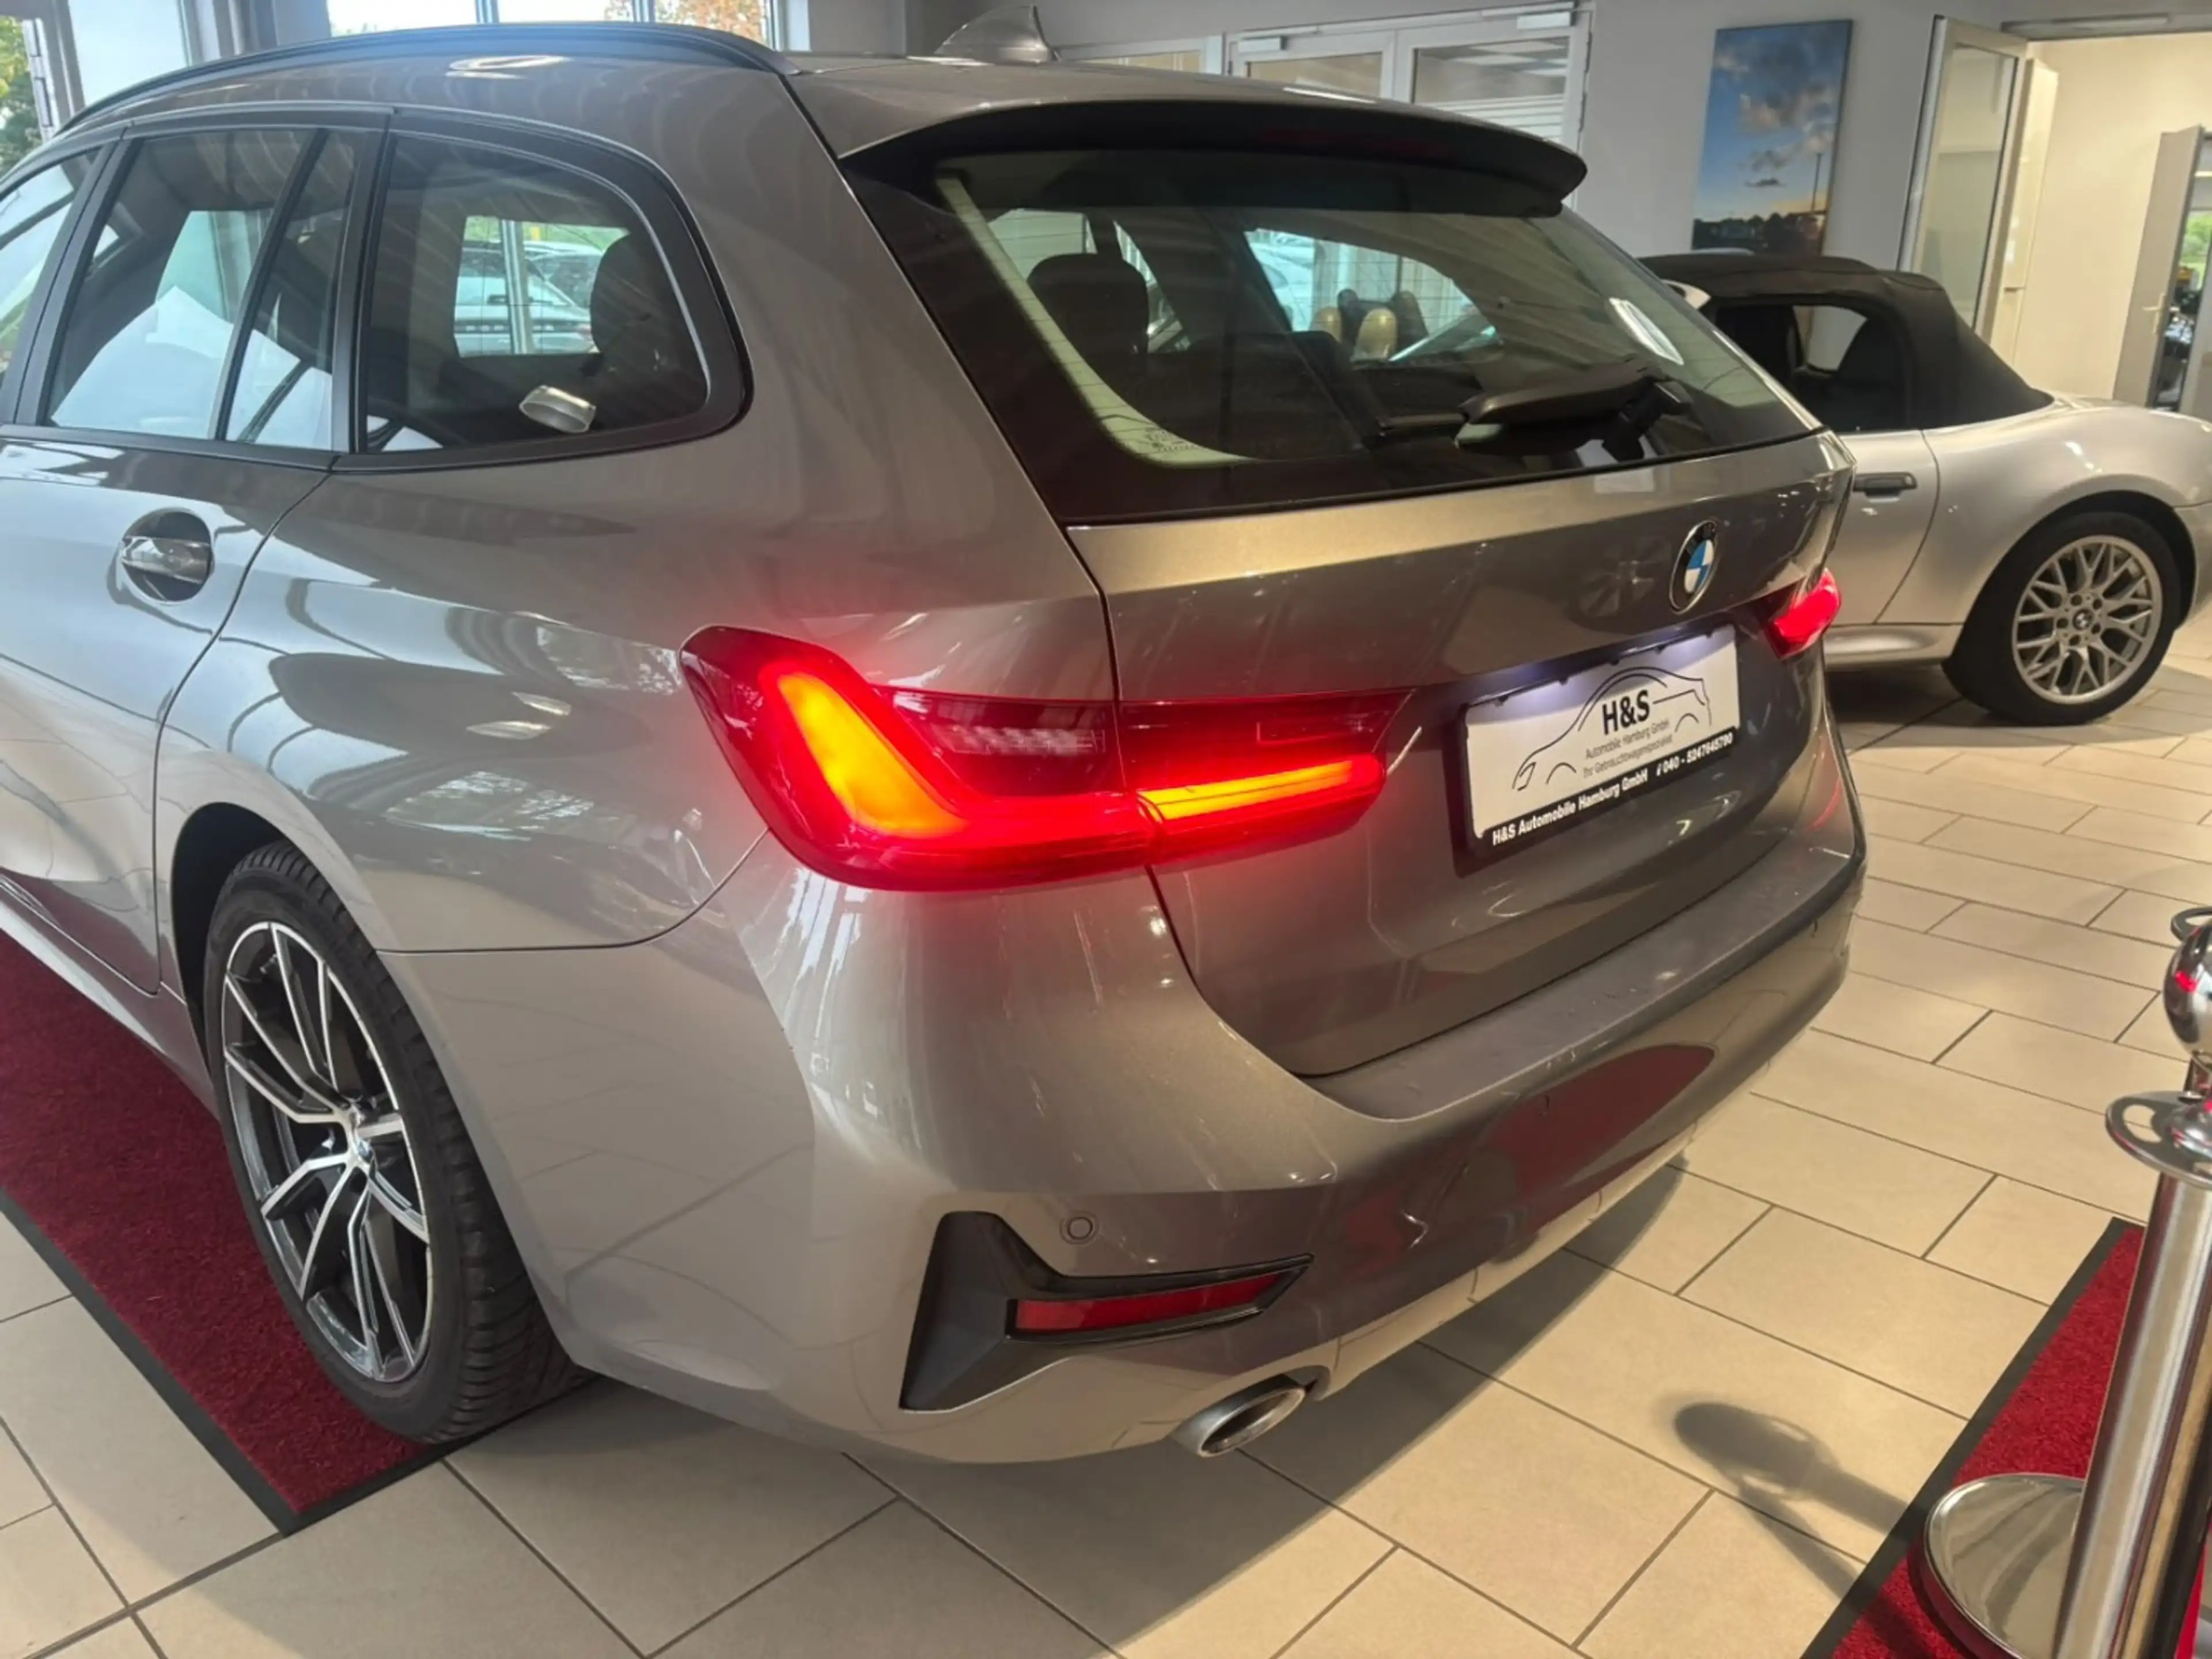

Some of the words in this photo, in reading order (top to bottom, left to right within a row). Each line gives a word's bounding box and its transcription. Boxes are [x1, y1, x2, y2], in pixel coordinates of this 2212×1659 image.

[1603, 690, 1650, 735] H&S
[1586, 738, 1621, 759] Automobile
[1622, 728, 1650, 745] Hamburg
[1651, 719, 1669, 734] GmbH
[1493, 823, 1516, 846] H&S
[1518, 801, 1576, 835] Automobile
[1578, 783, 1620, 810] Hamburg
[1622, 768, 1647, 791] GmbH
